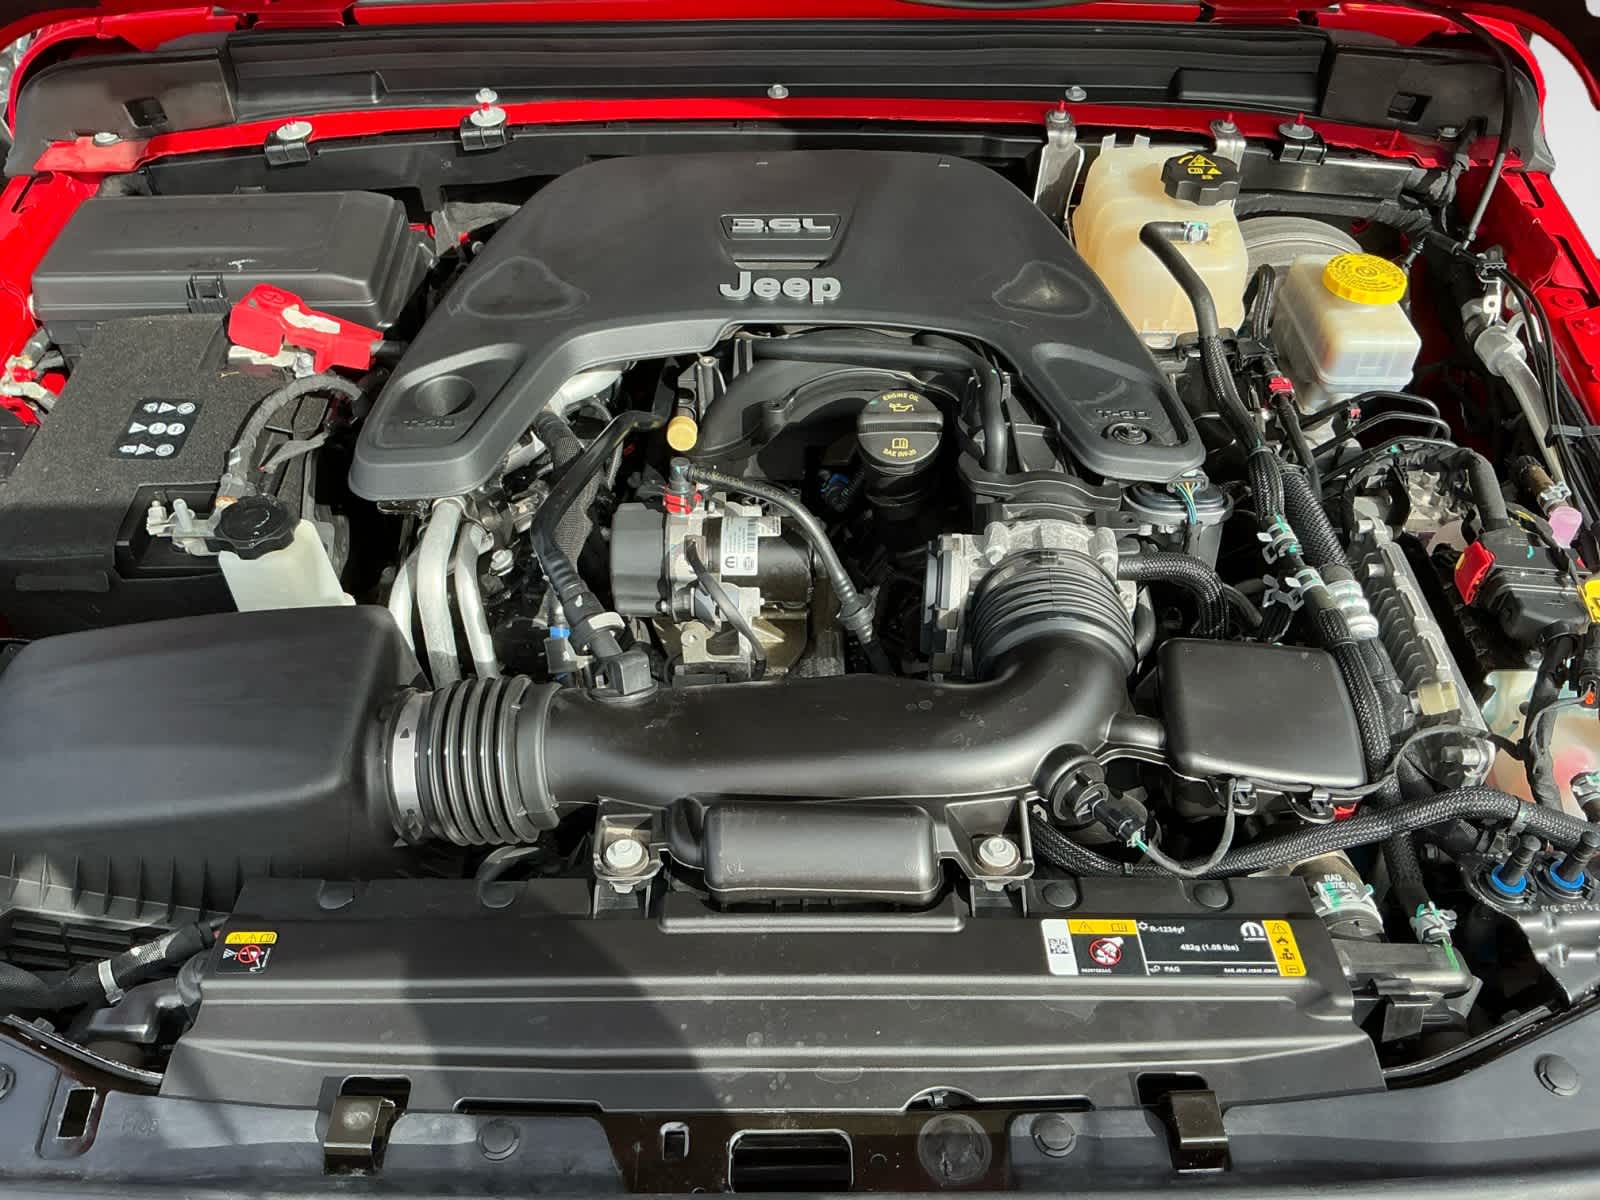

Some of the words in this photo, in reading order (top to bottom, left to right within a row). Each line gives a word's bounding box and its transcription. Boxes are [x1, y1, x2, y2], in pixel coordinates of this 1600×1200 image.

[731, 217, 831, 233] 3.6L
[718, 271, 841, 305] Jeep
[882, 392, 908, 401] ENGINE
[908, 393, 919, 402] OIL
[1324, 874, 1343, 882] RAD
